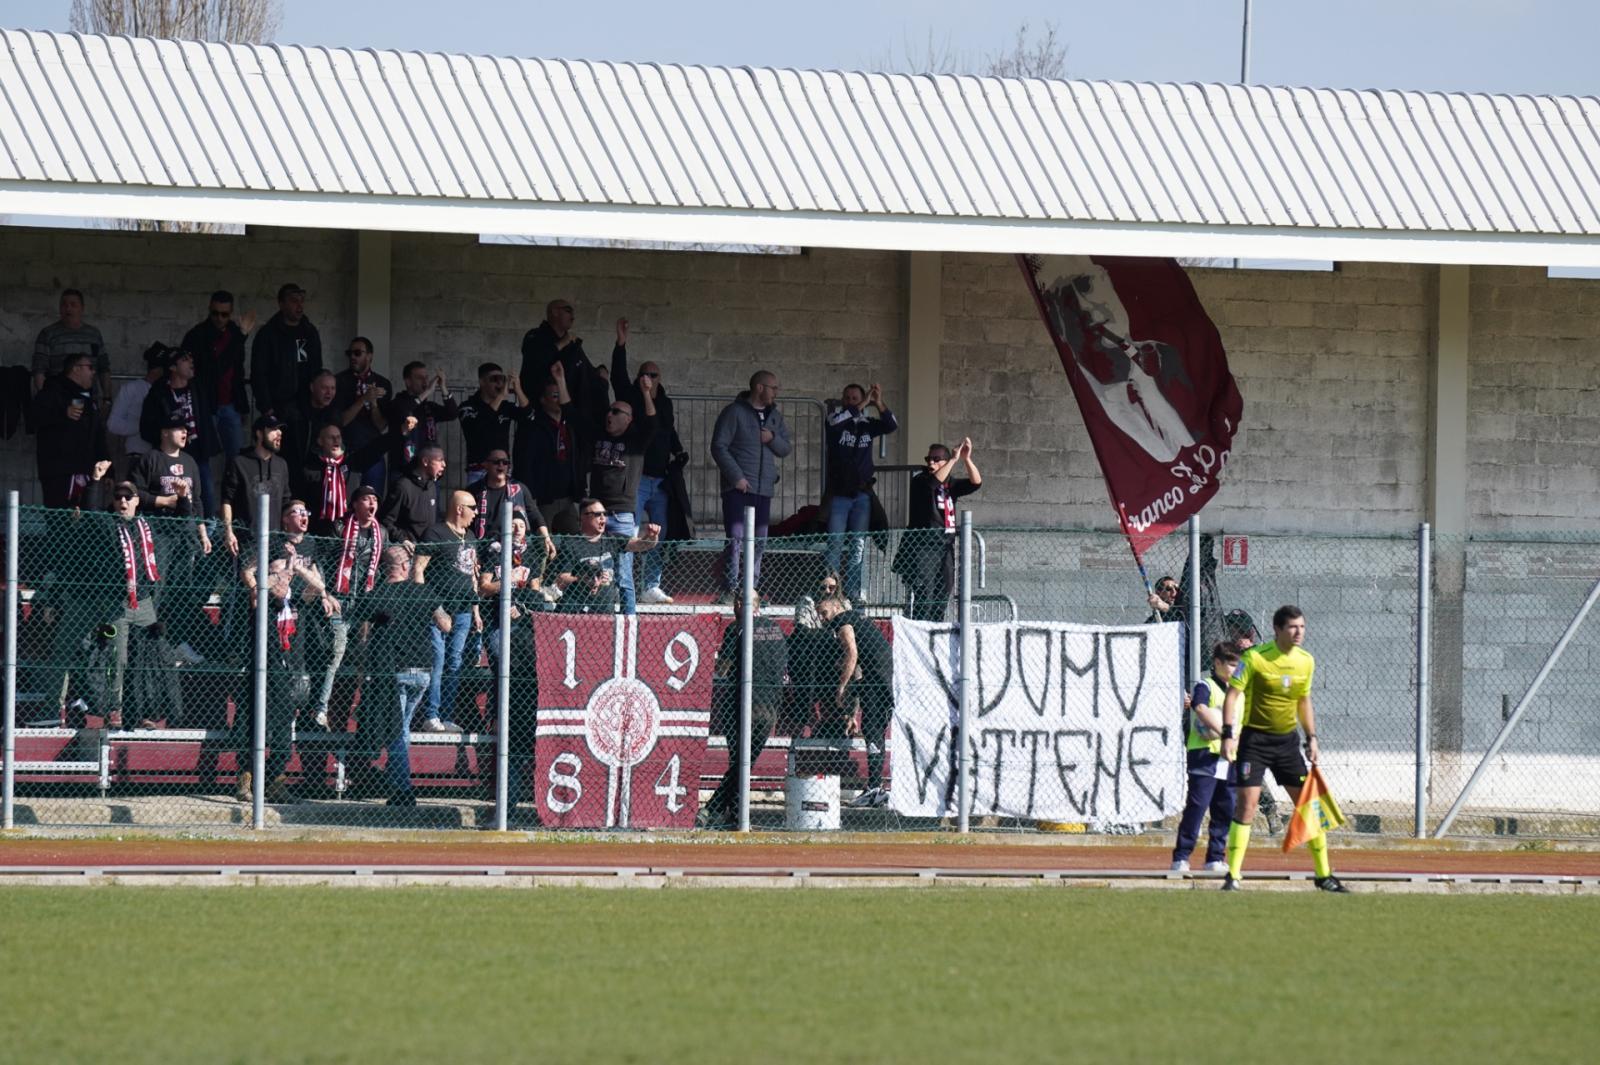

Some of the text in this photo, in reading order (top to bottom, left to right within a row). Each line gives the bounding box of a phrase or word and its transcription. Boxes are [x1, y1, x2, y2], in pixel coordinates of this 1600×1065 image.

[559, 629, 700, 692] 1 9
[546, 752, 687, 814] 8 4
